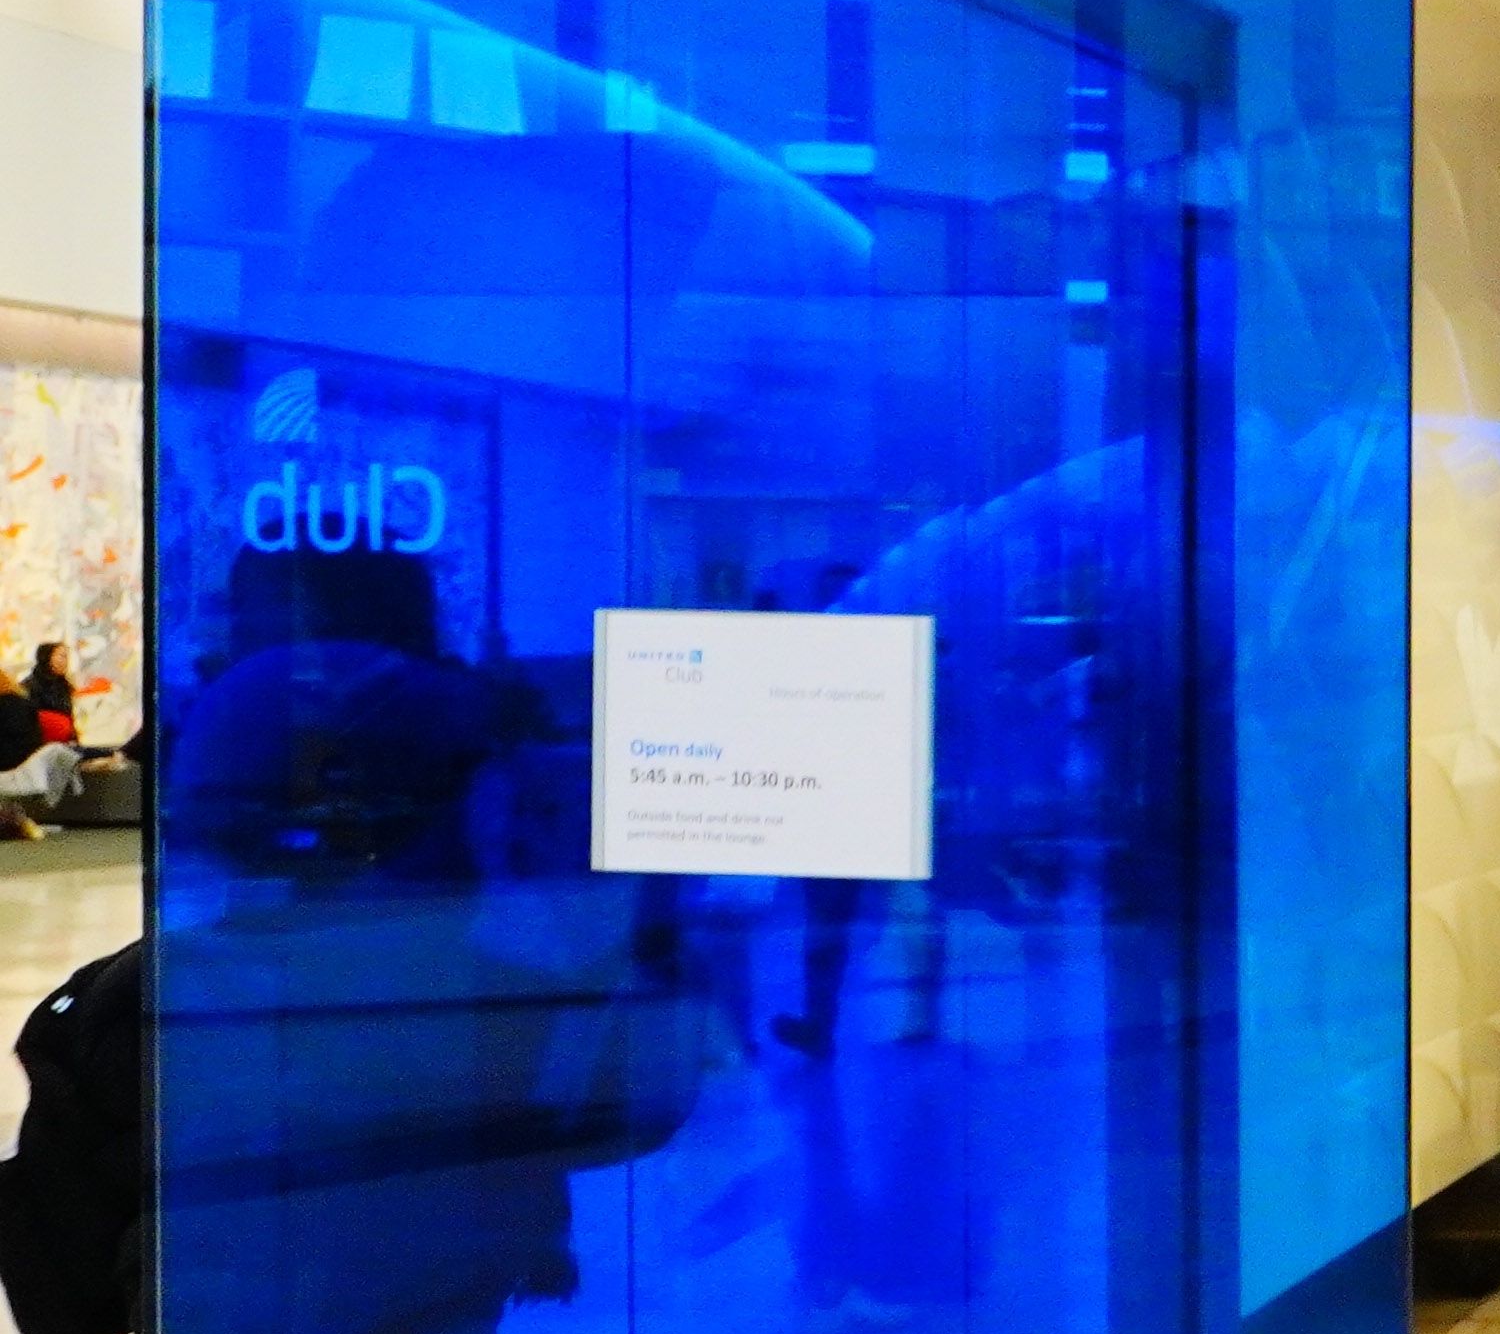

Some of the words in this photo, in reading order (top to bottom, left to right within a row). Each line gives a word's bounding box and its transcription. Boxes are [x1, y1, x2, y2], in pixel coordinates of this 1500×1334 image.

[664, 665, 703, 684] Club
[809, 686, 823, 700] of
[824, 688, 886, 703] operation
[630, 739, 680, 760] Open
[684, 741, 724, 762] daily
[630, 766, 667, 784] 5:45
[672, 771, 711, 787] a.m.
[732, 770, 779, 788] 10:30
[783, 774, 823, 792] p.m.
[705, 811, 728, 824] and
[763, 813, 785, 826] not
[702, 829, 723, 843] the
